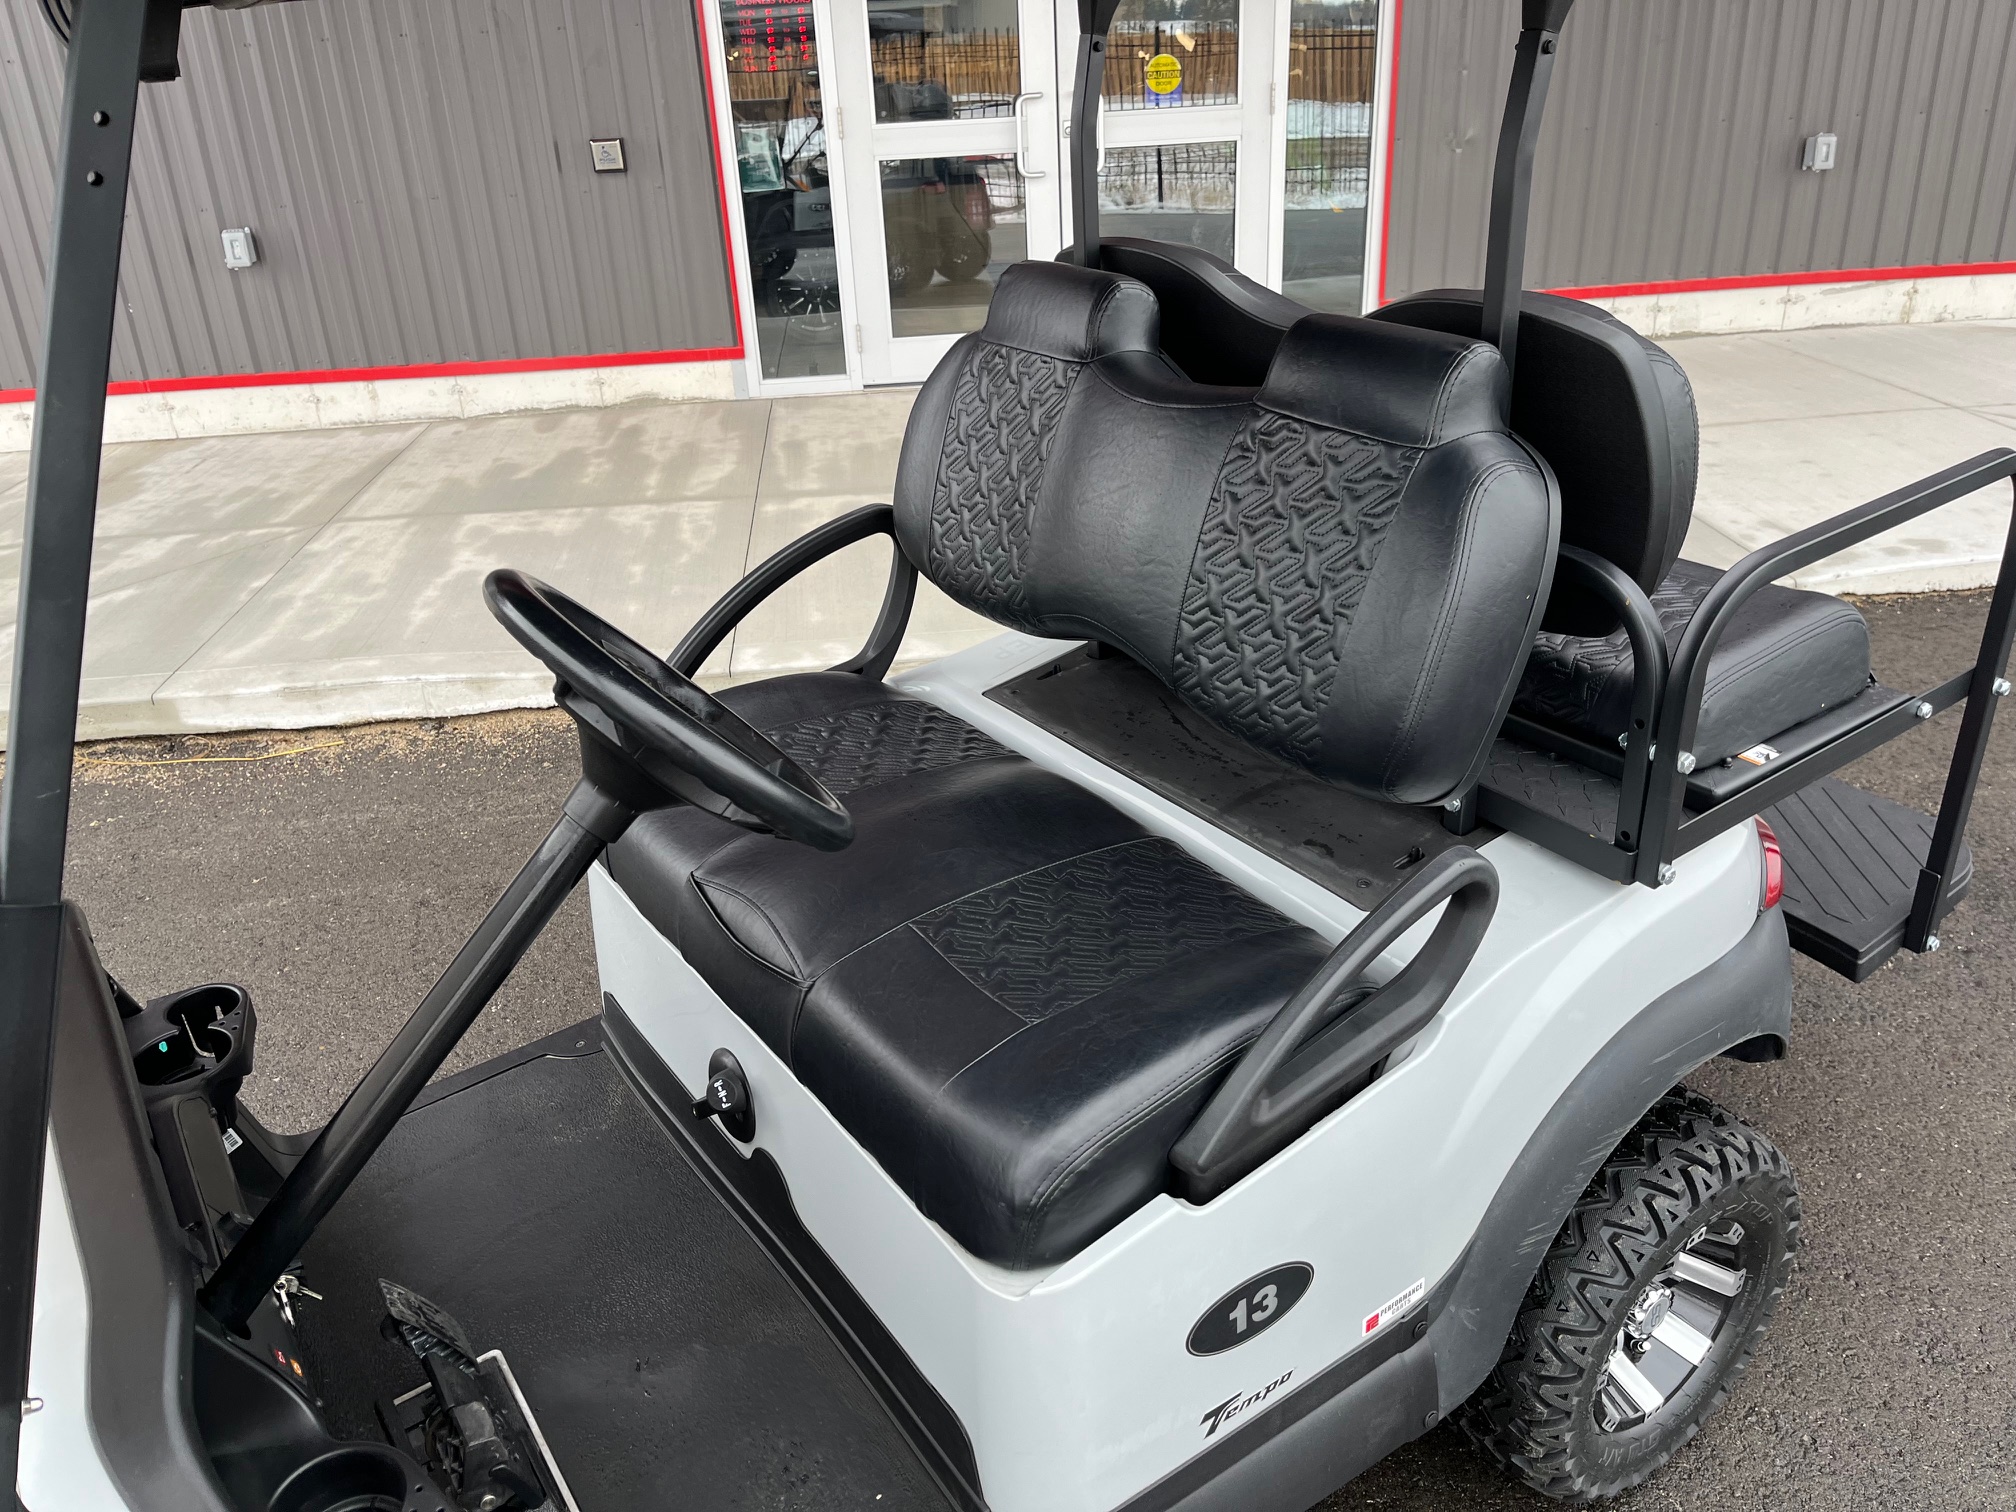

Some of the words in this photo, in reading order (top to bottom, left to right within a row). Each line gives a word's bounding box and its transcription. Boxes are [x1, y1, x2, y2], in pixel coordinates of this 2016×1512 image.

[1147, 71, 1180, 79] CAUTION
[1229, 1284, 1278, 1334] 13
[1380, 1281, 1423, 1317] PERFORMANCE
[1391, 1297, 1411, 1315] CARTS
[1199, 1369, 1294, 1439] Tempo
